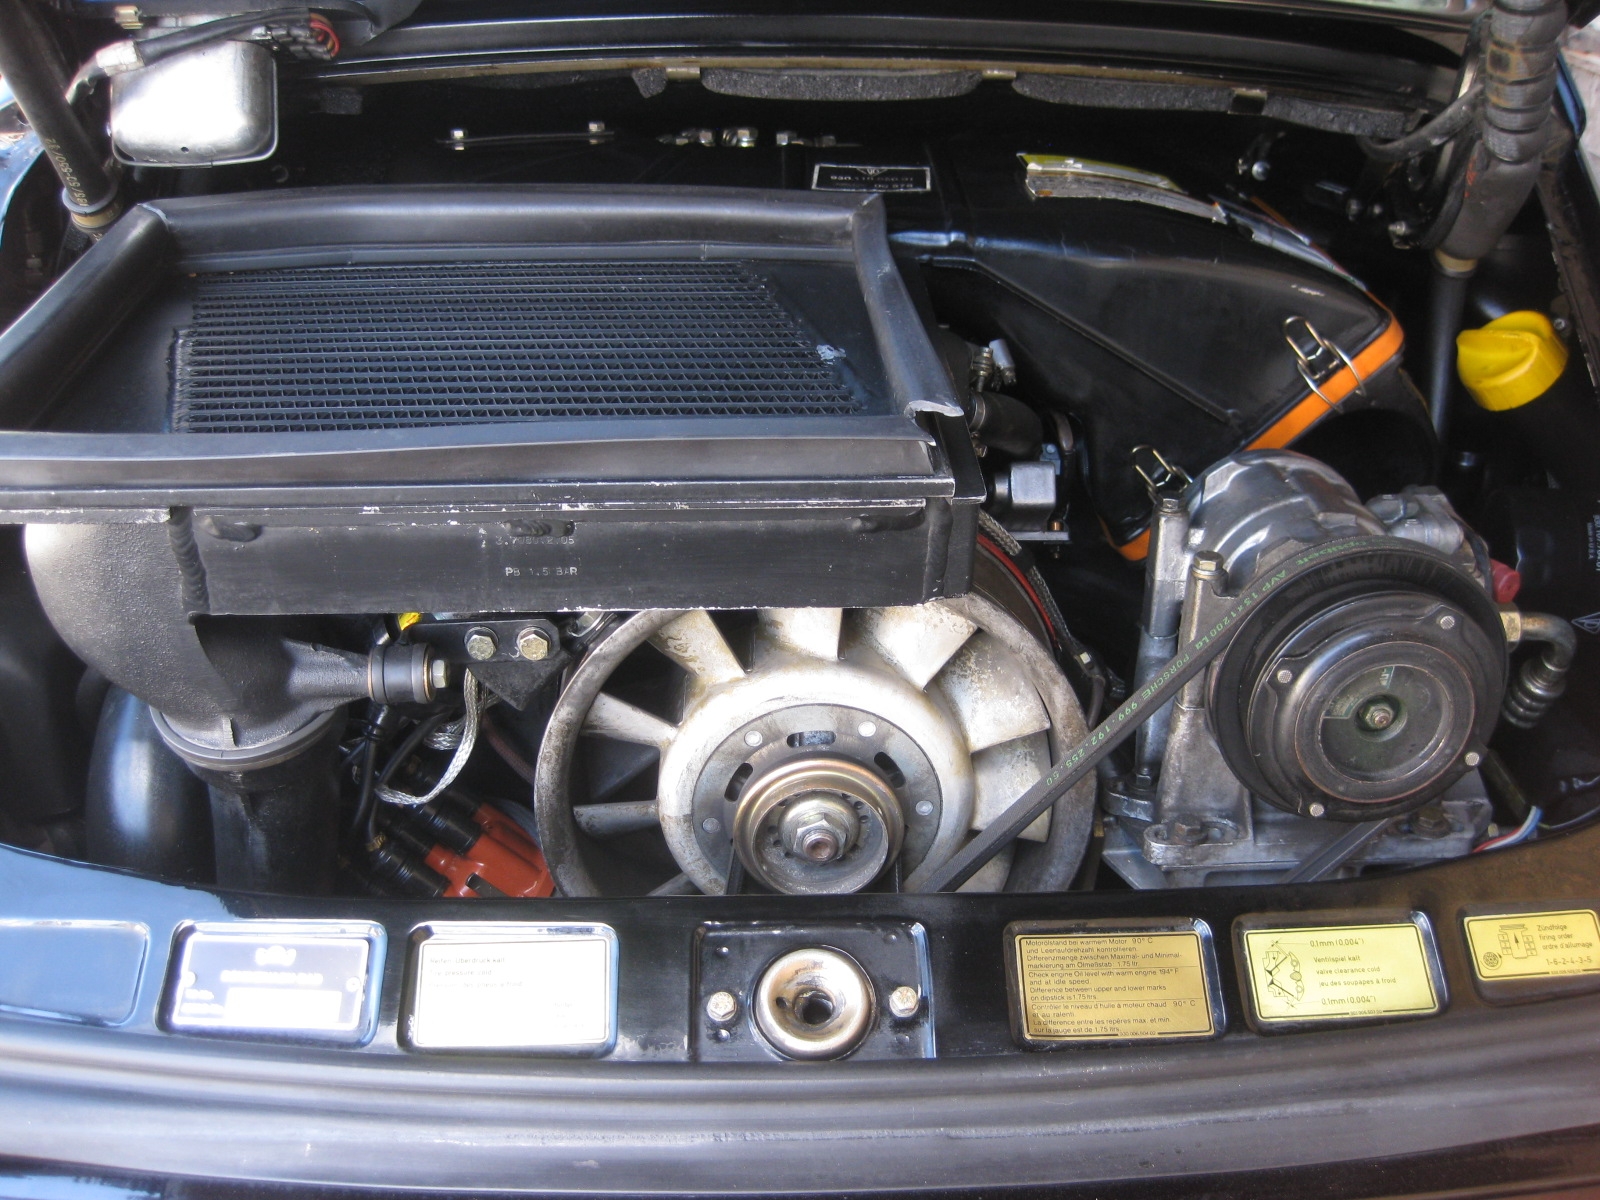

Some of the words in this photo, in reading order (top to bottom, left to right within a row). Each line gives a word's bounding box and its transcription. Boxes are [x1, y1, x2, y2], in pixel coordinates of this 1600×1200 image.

[505, 566, 520, 576] PB
[556, 566, 578, 576] BAR
[1262, 570, 1286, 592] AVP
[1142, 653, 1189, 700] PORSCHE
